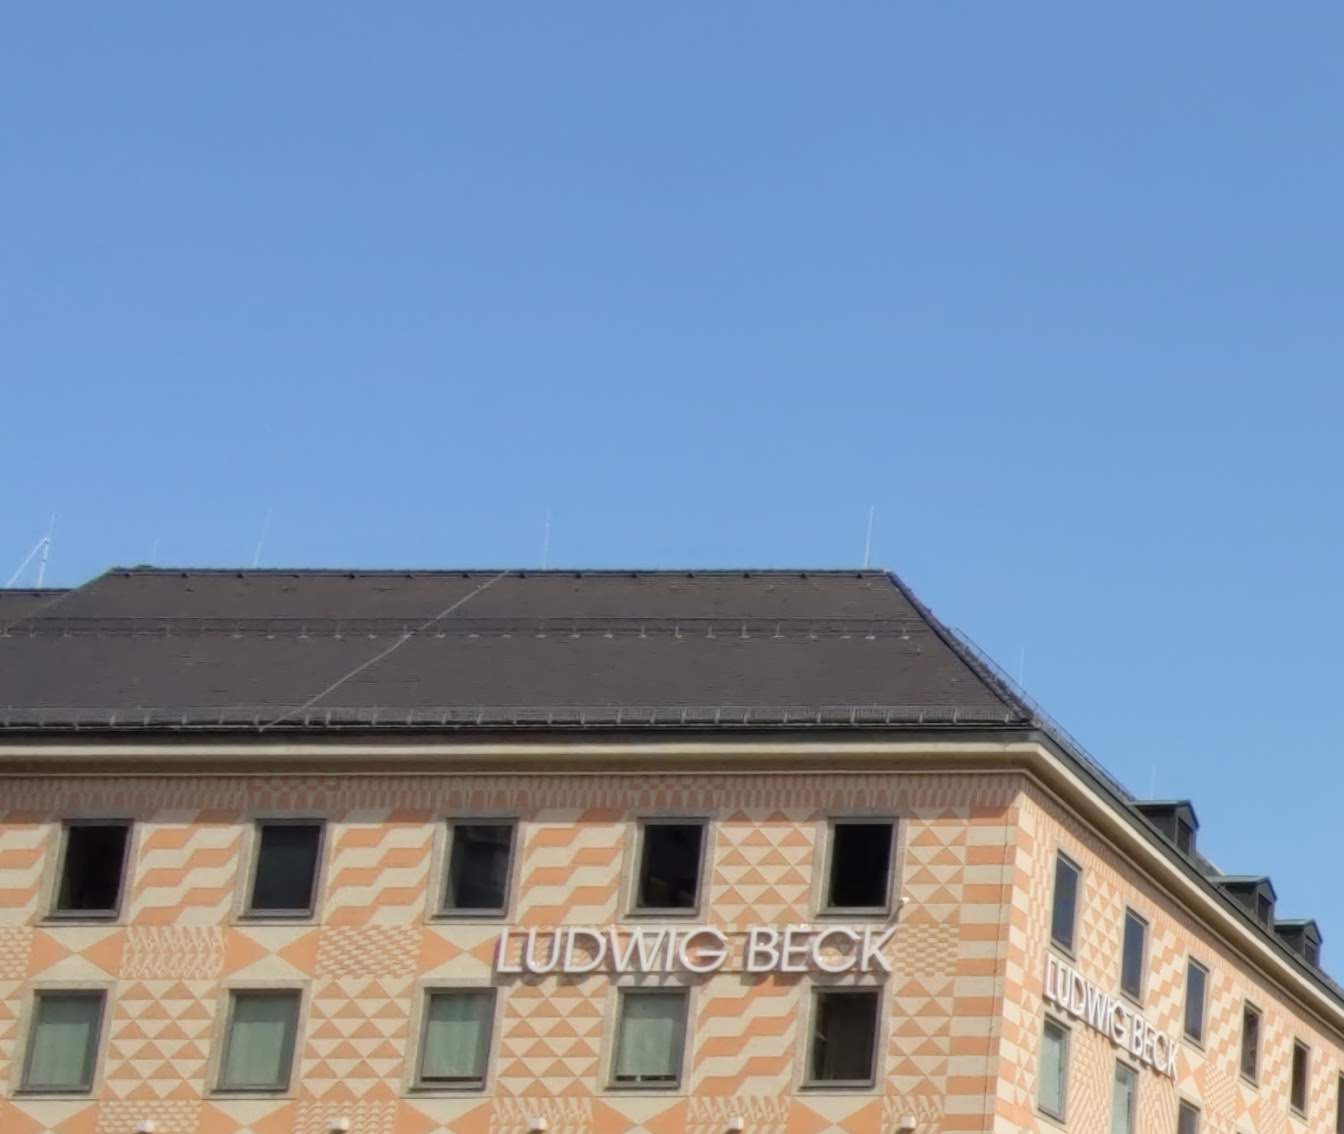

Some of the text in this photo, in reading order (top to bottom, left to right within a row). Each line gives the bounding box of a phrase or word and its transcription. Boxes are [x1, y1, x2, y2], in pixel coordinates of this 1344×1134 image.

[496, 925, 897, 974] LUDWIG BECK
[1045, 953, 1181, 1080] LUDWIG BECK
